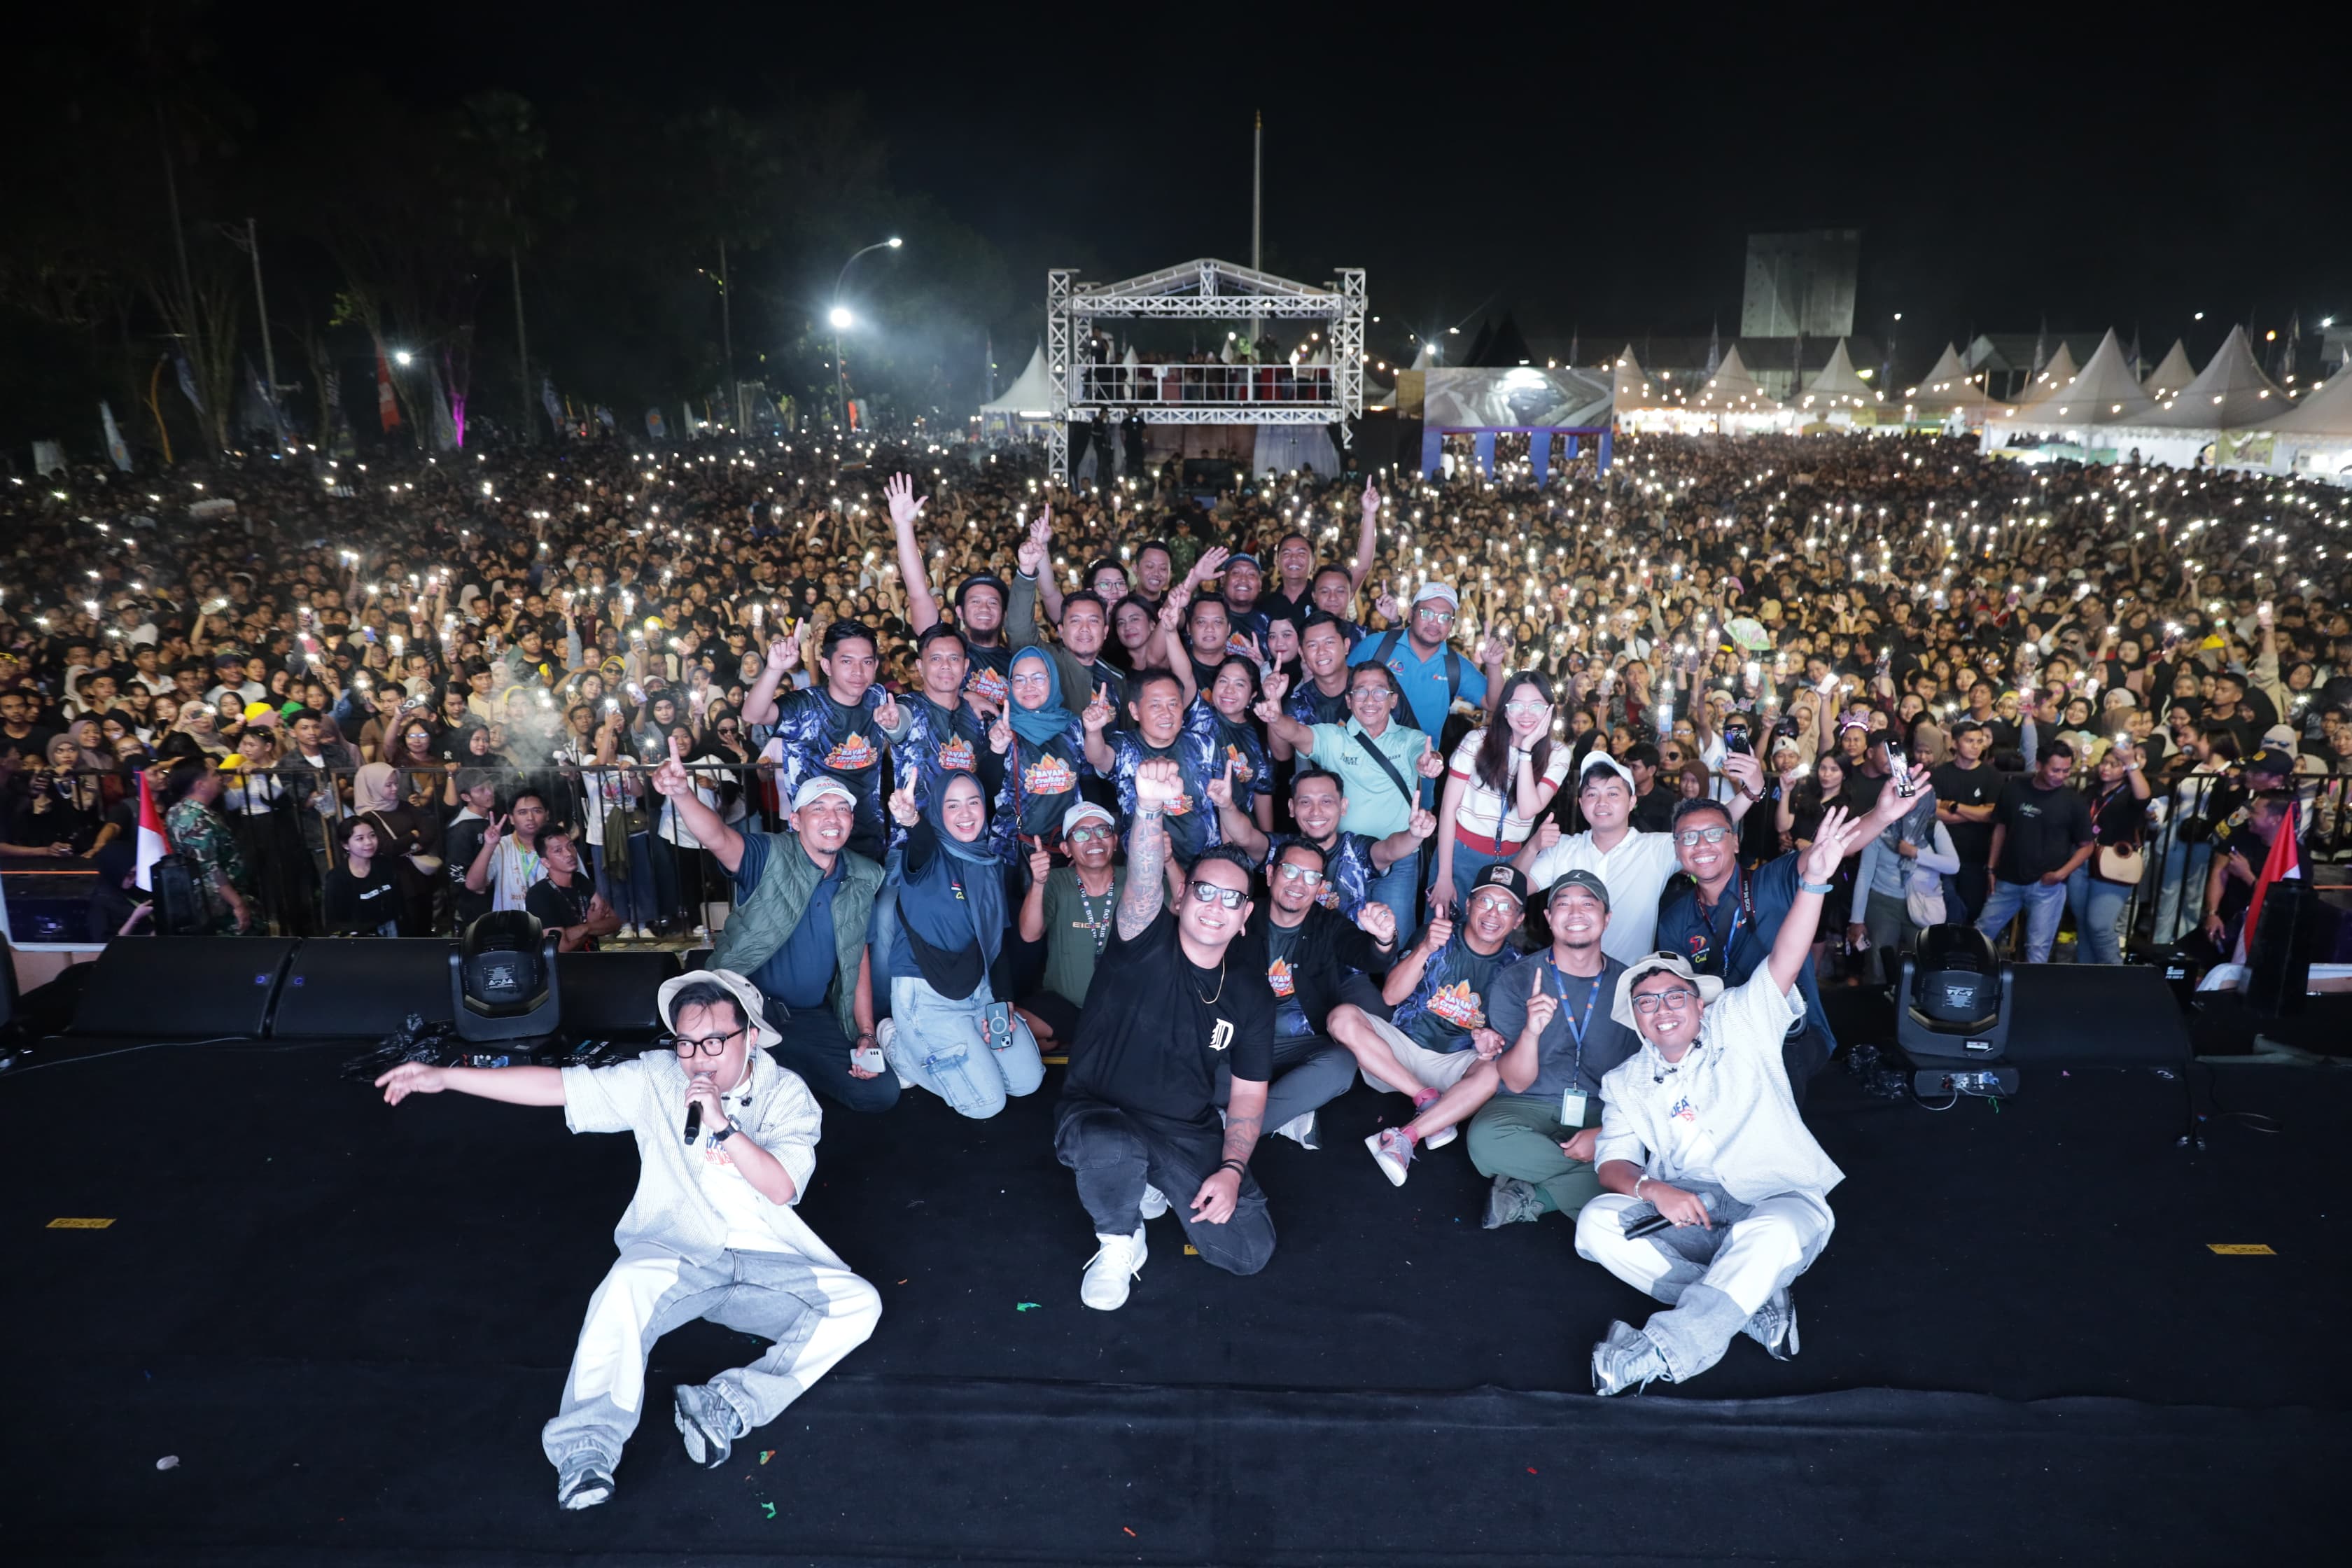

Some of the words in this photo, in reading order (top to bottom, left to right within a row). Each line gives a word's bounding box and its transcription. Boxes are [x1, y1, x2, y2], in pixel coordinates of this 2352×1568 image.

[841, 747, 867, 756] BAYAN
[1036, 769, 1064, 778] BAYAN
[1444, 993, 1472, 1010] BAYAN
[1208, 1018, 1234, 1051] D
